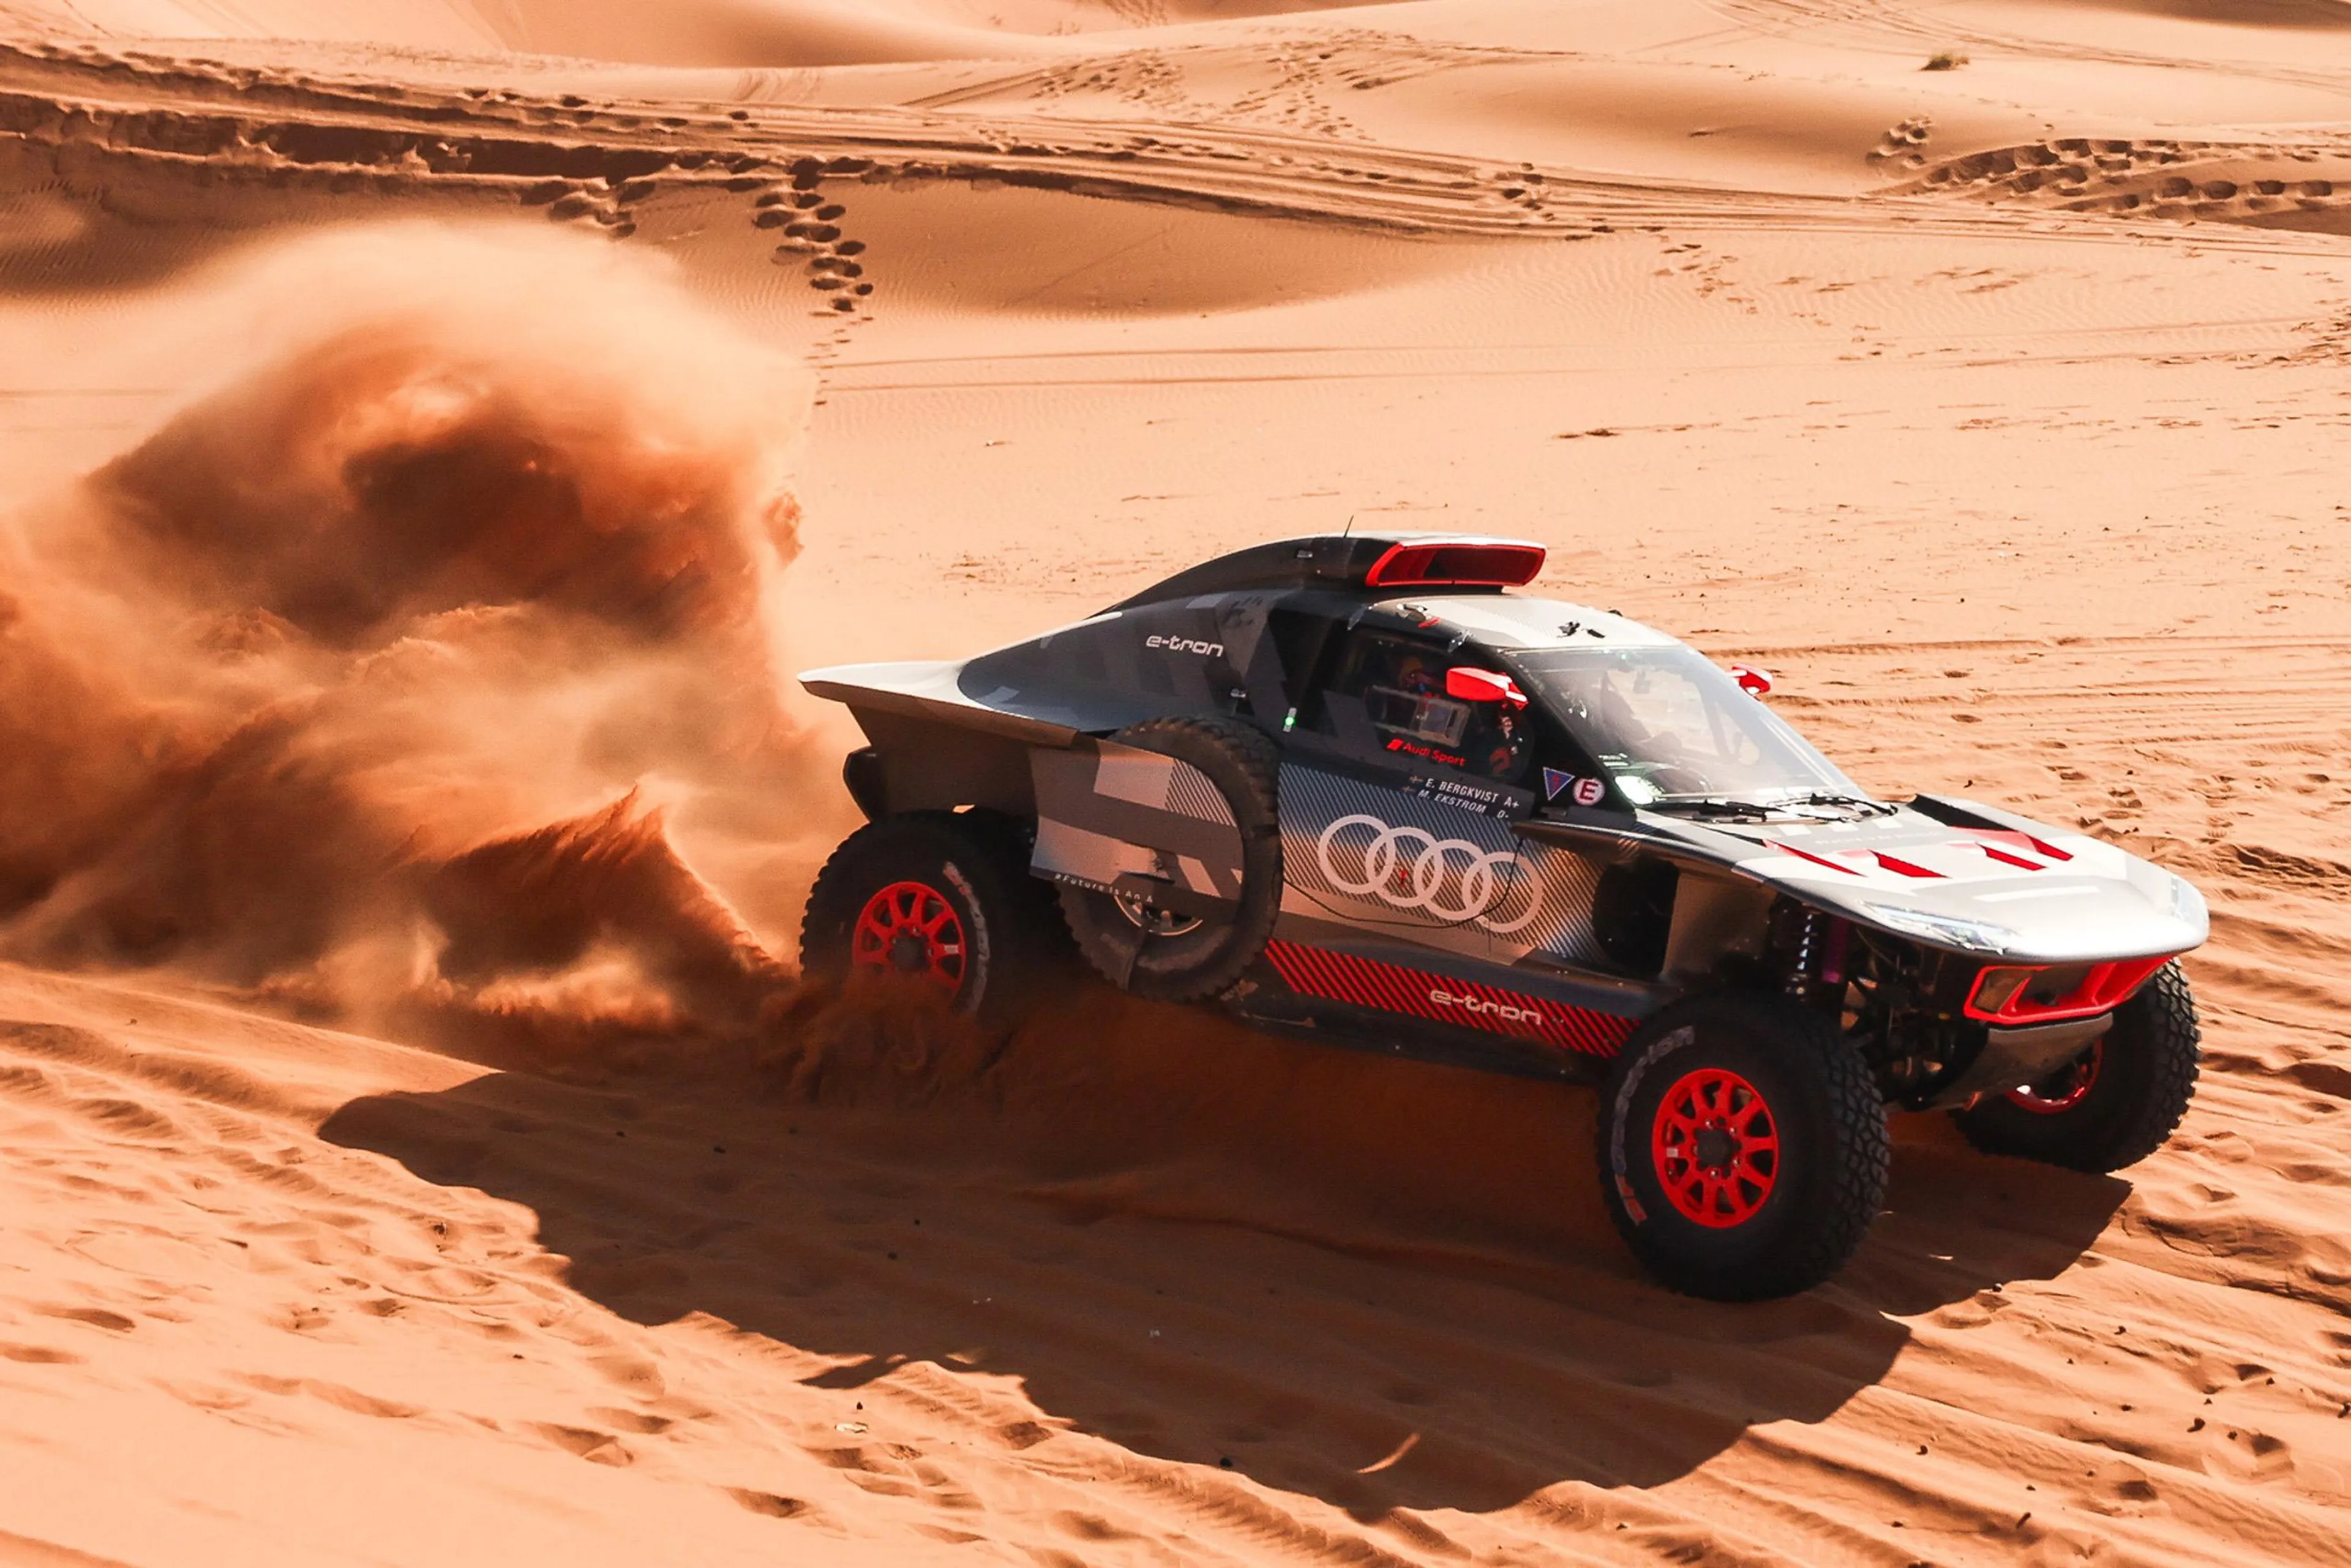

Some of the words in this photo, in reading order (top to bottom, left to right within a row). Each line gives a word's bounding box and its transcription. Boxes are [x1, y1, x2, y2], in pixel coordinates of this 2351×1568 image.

[1146, 635, 1224, 657] e-tron
[1403, 742, 1431, 757] Audi
[1432, 749, 1466, 767] Sport
[1417, 789, 1430, 800] M.
[1434, 793, 1487, 814] EKSTROM
[1425, 778, 1436, 789] E.
[1439, 781, 1499, 803] BERGKVIST
[1504, 796, 1520, 809] A+
[1579, 780, 1599, 801] E
[1430, 989, 1542, 1026] e-tron
